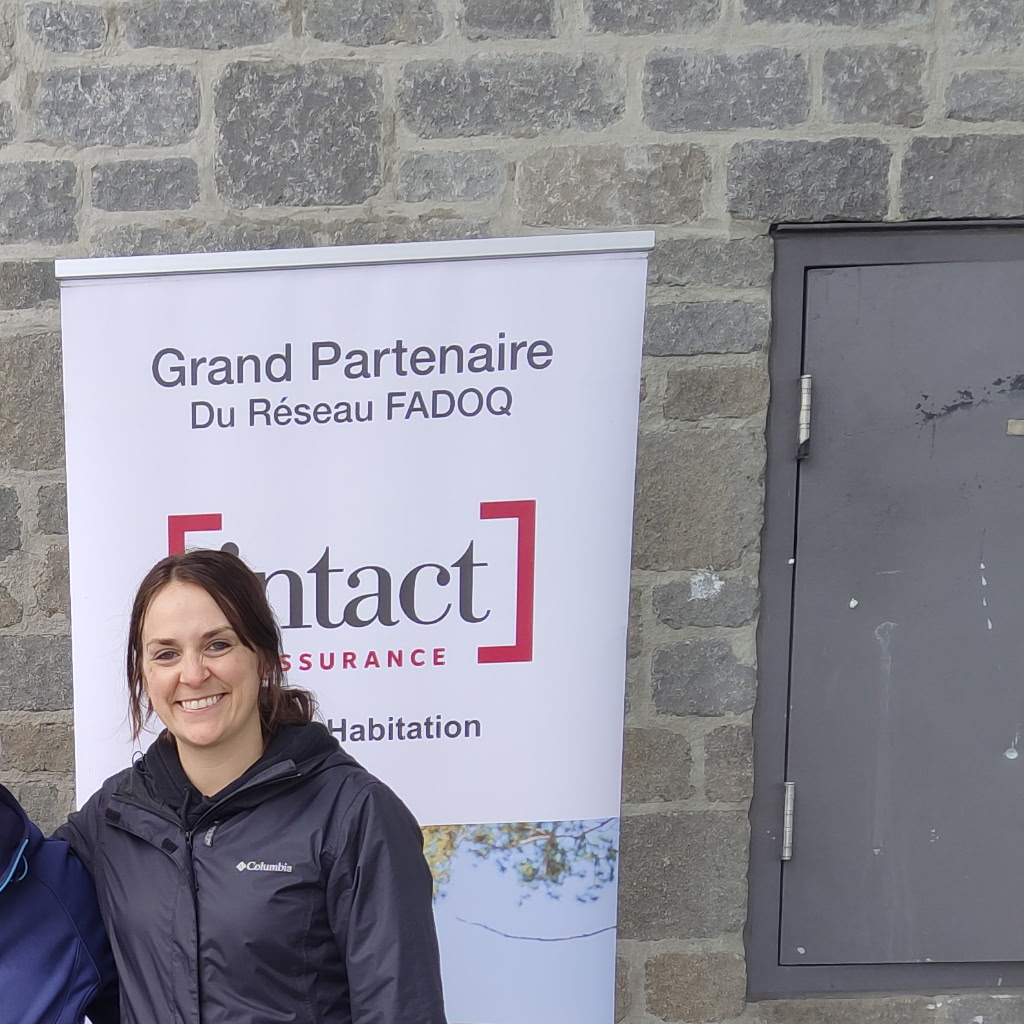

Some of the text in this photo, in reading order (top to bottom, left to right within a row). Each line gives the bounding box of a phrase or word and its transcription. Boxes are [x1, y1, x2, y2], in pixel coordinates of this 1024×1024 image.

[151, 332, 554, 388] Grand Partenaire
[190, 385, 513, 430] Du Réseau FADOQ
[279, 647, 446, 672] SSURANCE
[326, 714, 481, 743] Habitation
[246, 861, 293, 873] Columbia
